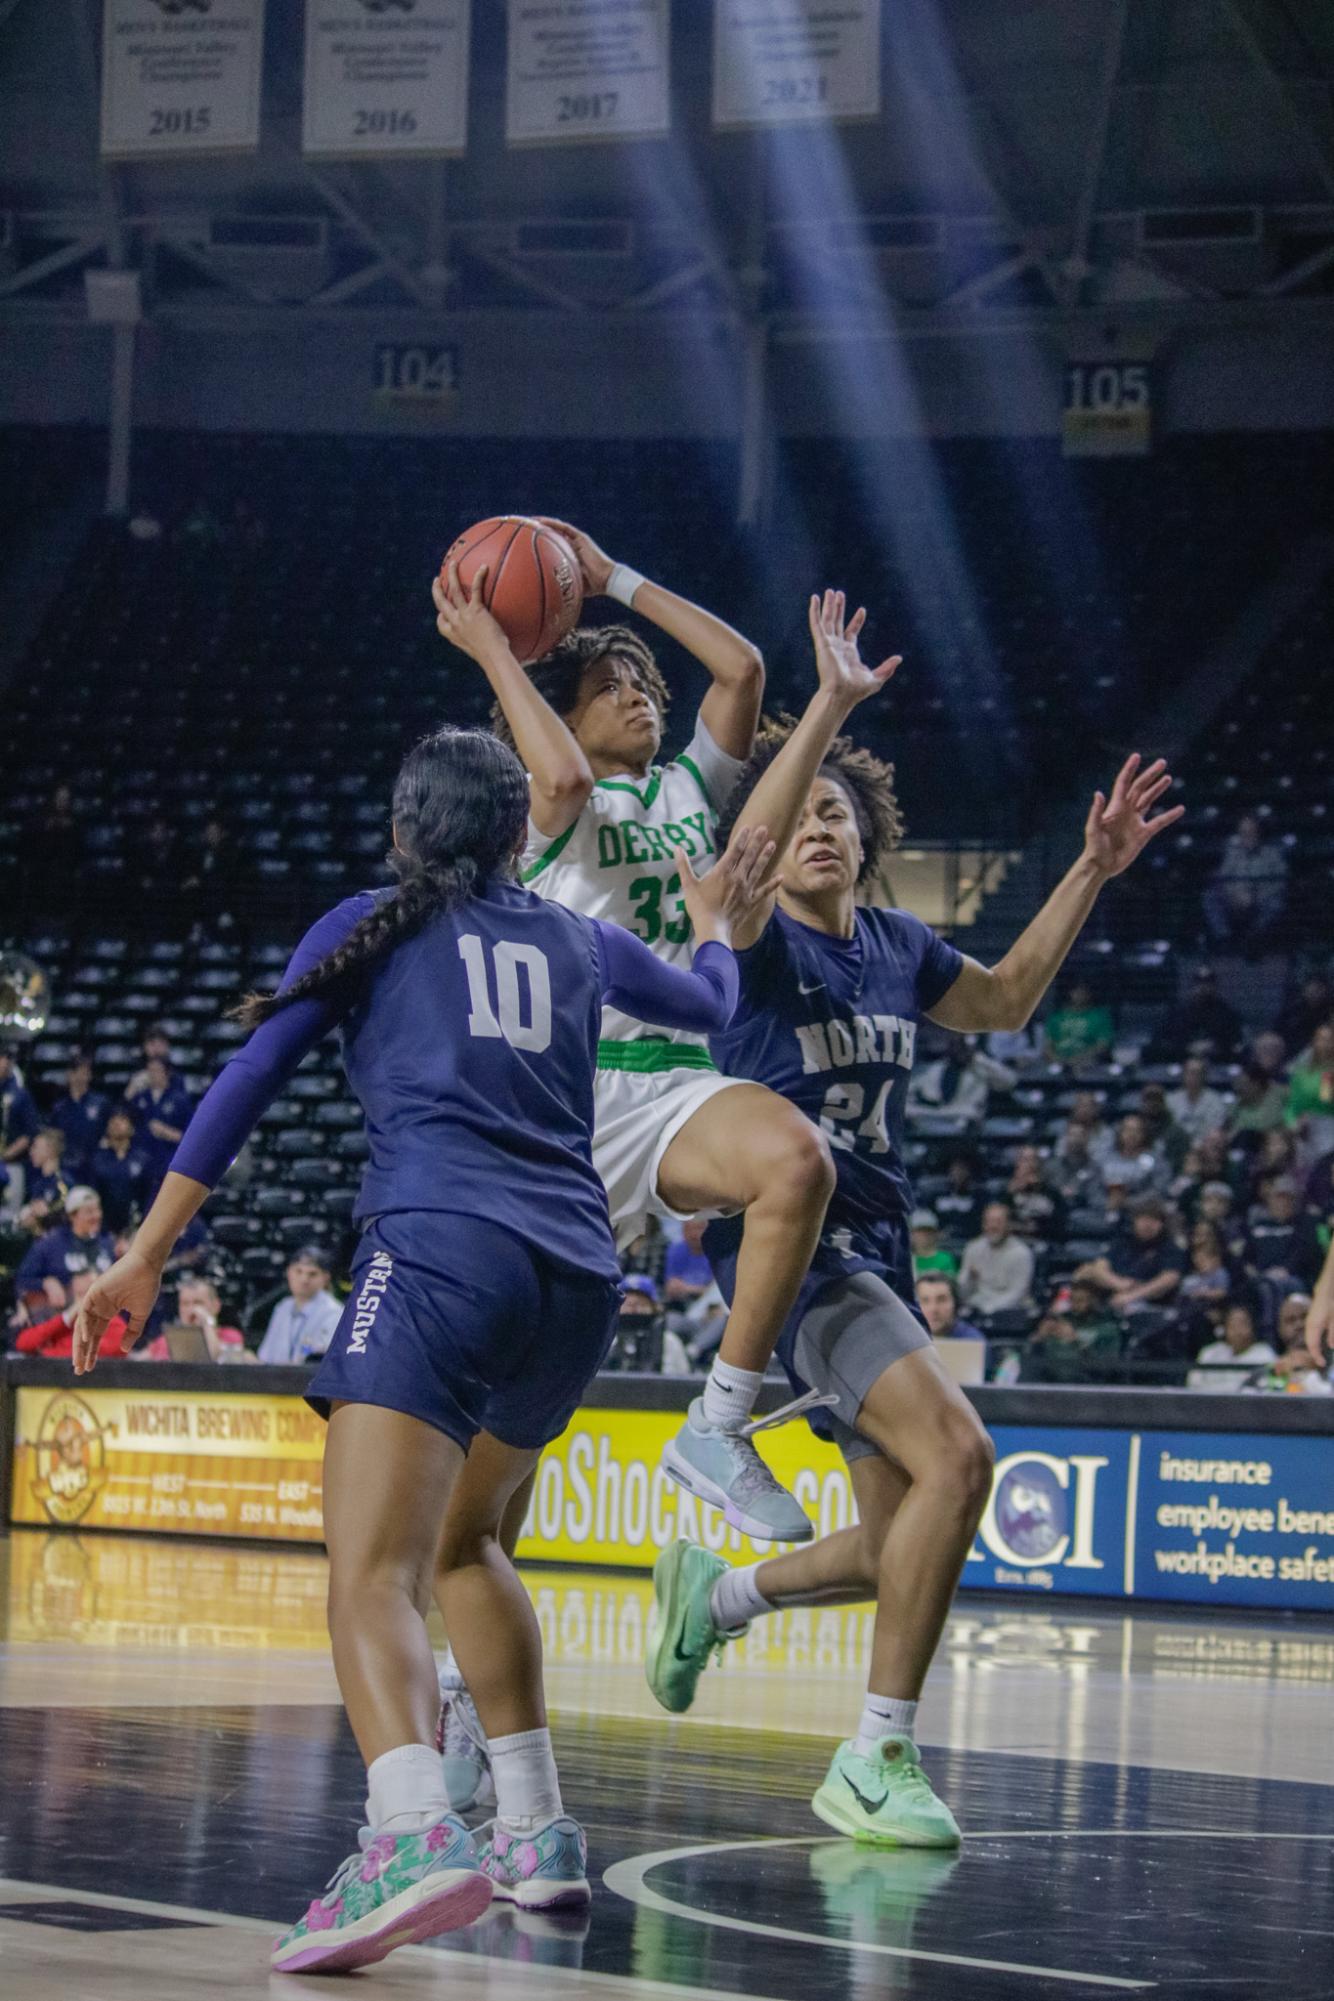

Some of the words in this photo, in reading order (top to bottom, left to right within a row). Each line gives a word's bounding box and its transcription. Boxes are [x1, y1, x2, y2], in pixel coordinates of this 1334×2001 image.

[149, 107, 211, 136] 2015
[353, 109, 417, 136] 2016
[557, 92, 619, 122] 2017
[379, 348, 454, 389] 104
[1069, 366, 1150, 410] 105
[597, 812, 715, 869] DERBY
[457, 933, 552, 1054] 10
[794, 1014, 917, 1075] NORTH
[819, 1079, 890, 1154] 24
[125, 1405, 191, 1437] WICHITA
[196, 1407, 270, 1441] BREWING
[1159, 1451, 1272, 1485] insurance
[278, 1480, 309, 1501] EAST
[966, 1451, 1109, 1568] CI
[1157, 1494, 1275, 1539] employee
[1155, 1540, 1275, 1584] workplace
